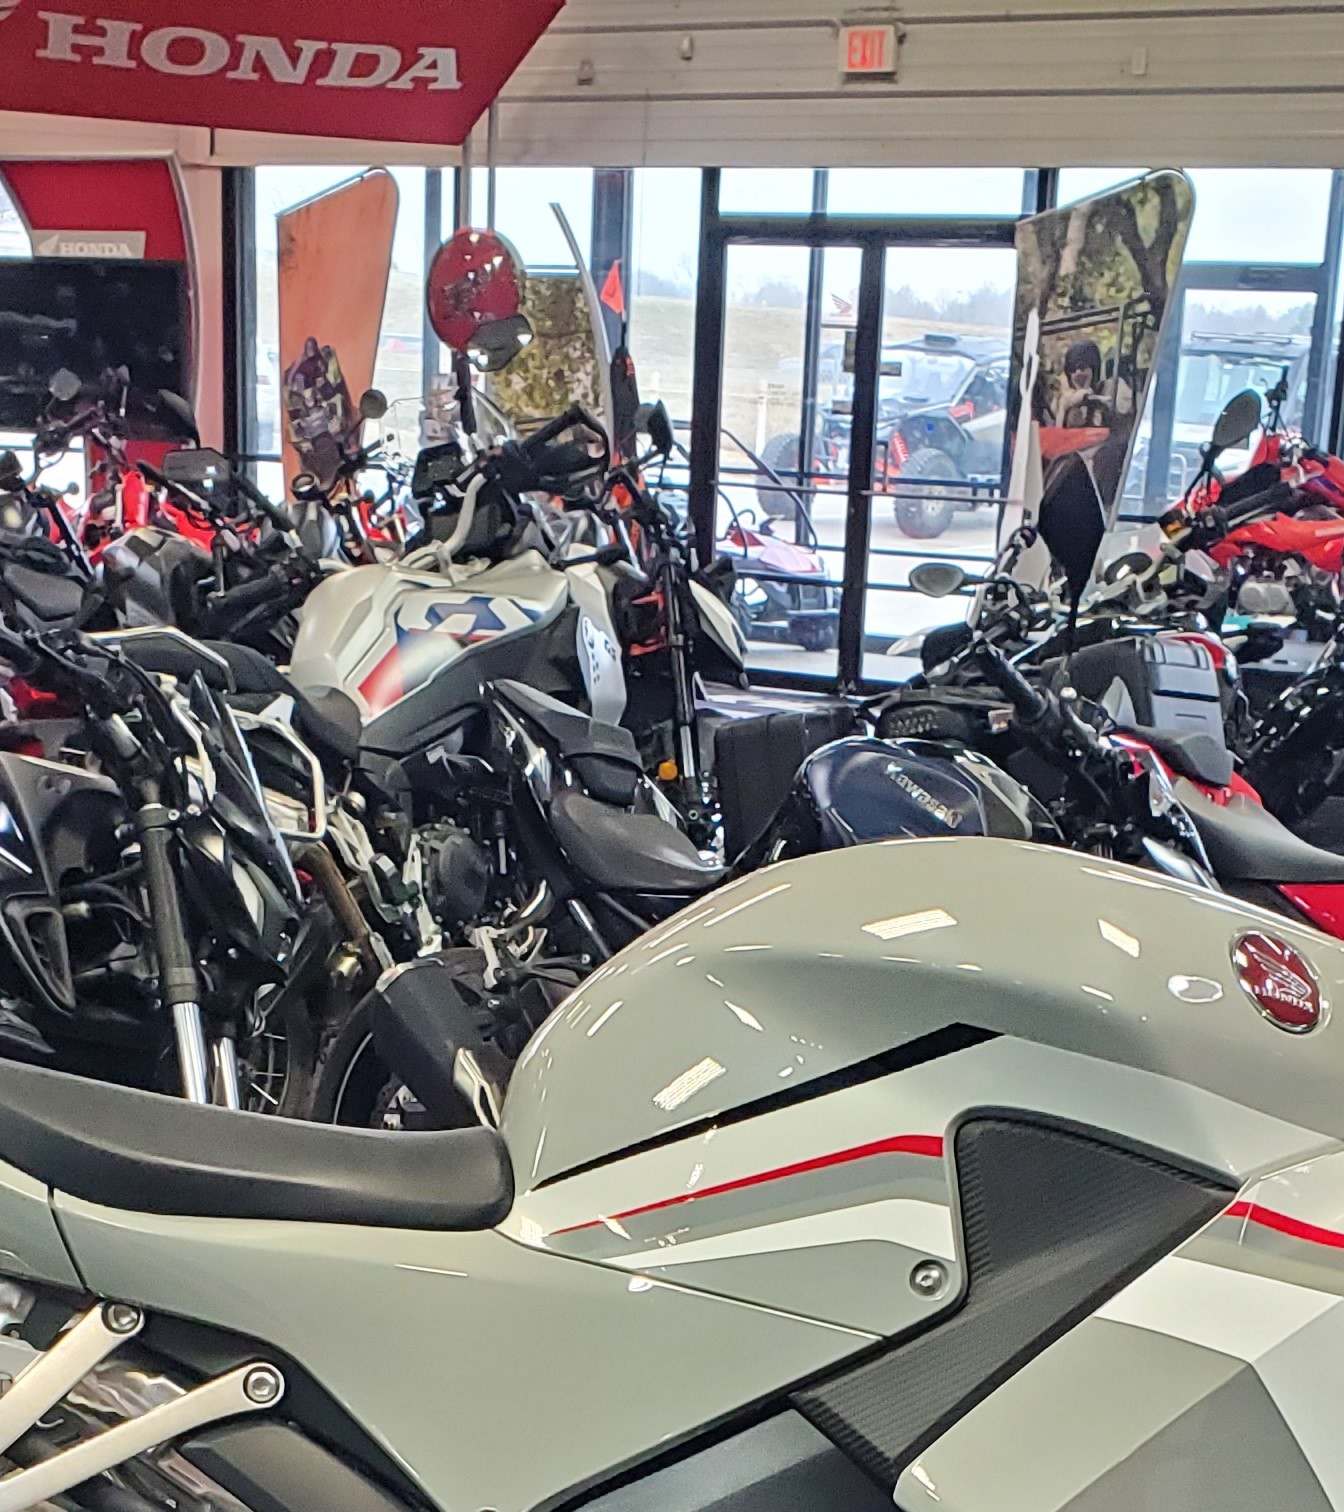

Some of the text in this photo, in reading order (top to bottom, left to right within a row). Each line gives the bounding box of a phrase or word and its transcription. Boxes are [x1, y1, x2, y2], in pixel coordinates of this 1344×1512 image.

[35, 10, 463, 90] HONDA
[847, 30, 887, 69] EXIT
[59, 242, 133, 258] HONDA
